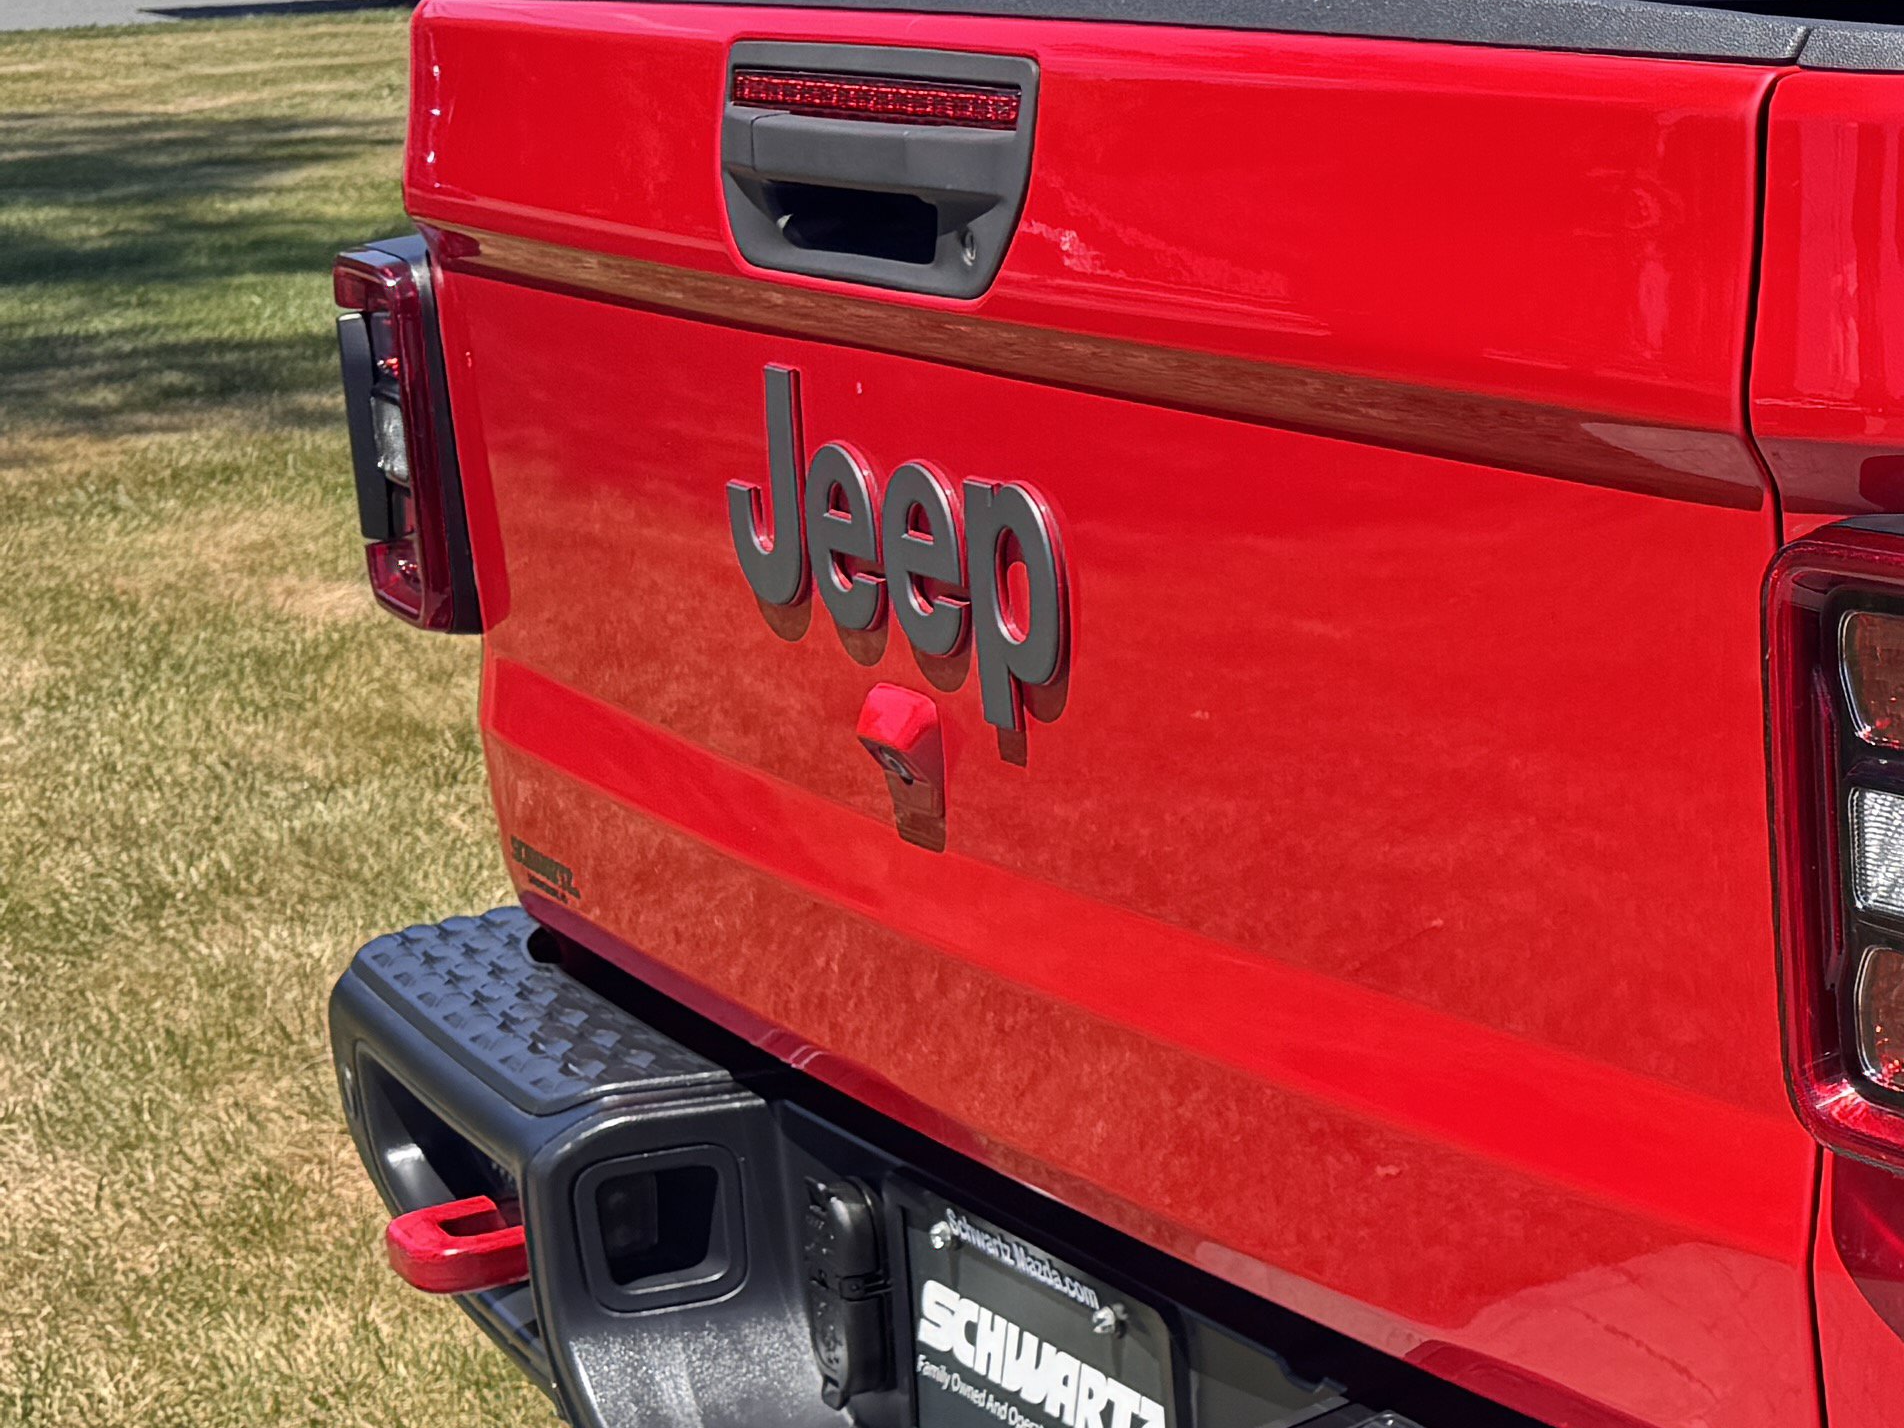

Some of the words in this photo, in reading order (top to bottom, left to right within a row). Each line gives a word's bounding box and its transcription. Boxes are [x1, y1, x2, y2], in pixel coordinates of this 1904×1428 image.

[725, 362, 1071, 730] Jeep
[917, 1353, 951, 1390] Family
[951, 1372, 986, 1408] Owned
[985, 1393, 1008, 1421] And
